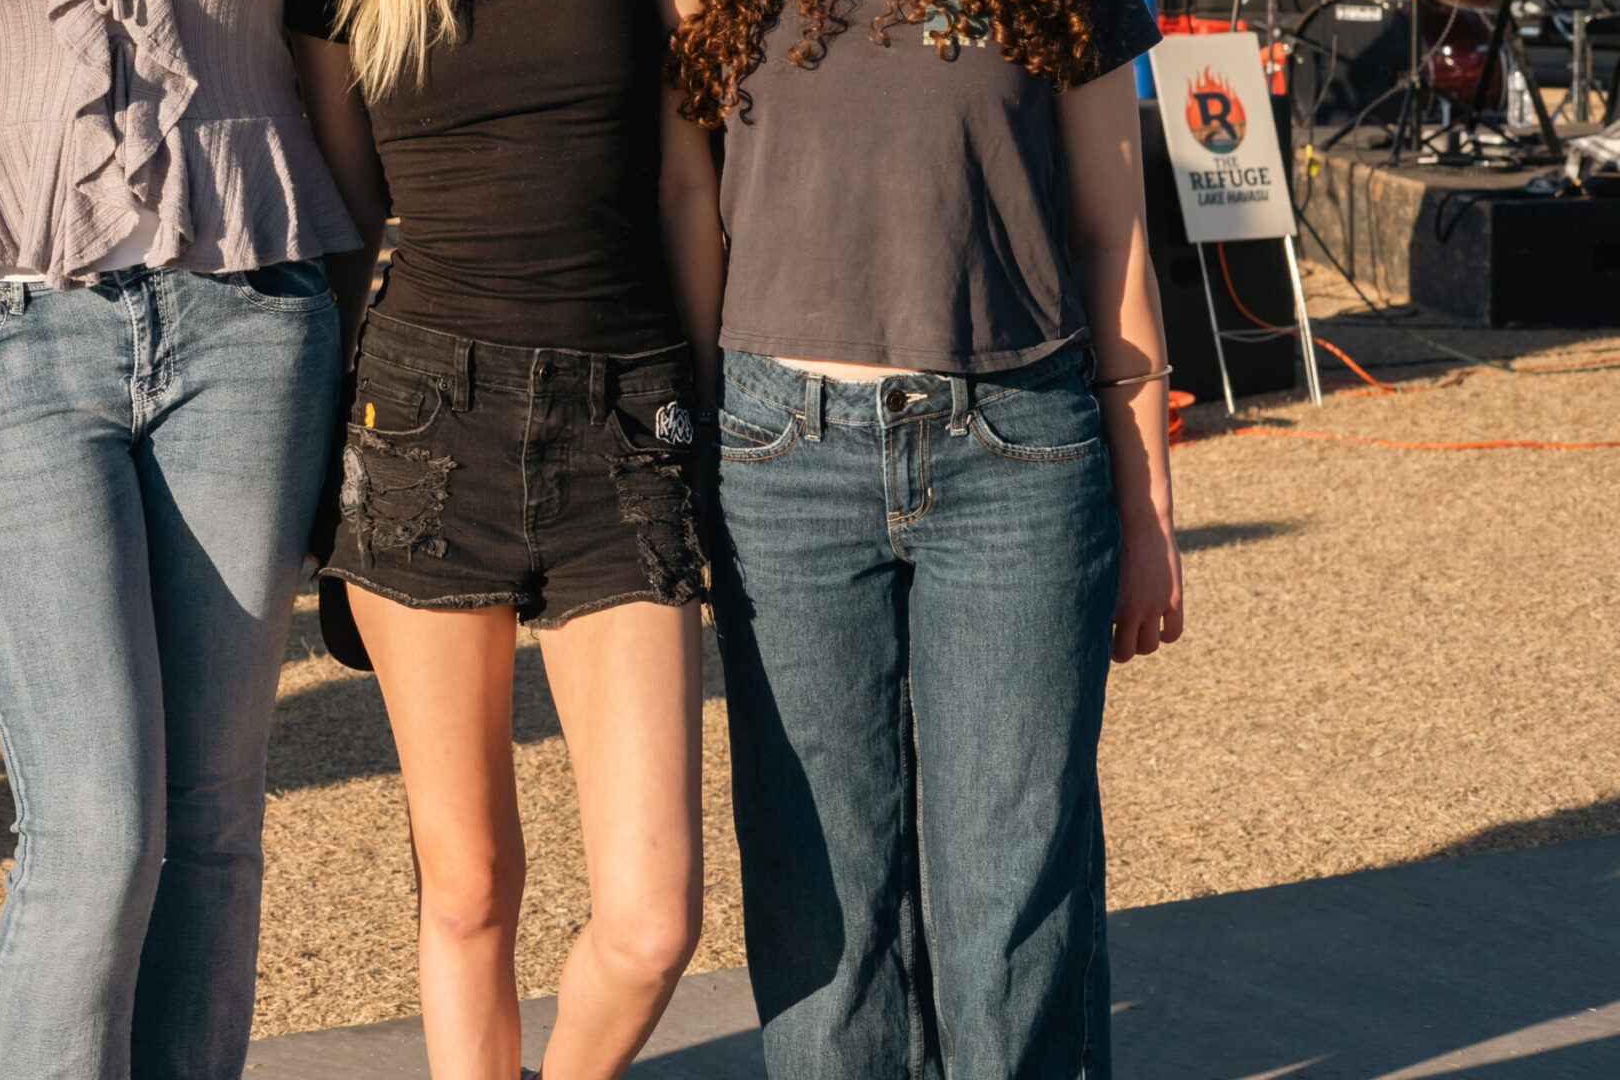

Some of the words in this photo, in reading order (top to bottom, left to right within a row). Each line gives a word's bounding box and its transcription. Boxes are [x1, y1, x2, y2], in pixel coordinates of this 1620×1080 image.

[1192, 92, 1237, 142] R
[1213, 156, 1238, 168] THE
[1189, 167, 1271, 191] REFUGE
[1198, 191, 1225, 206] LAKE
